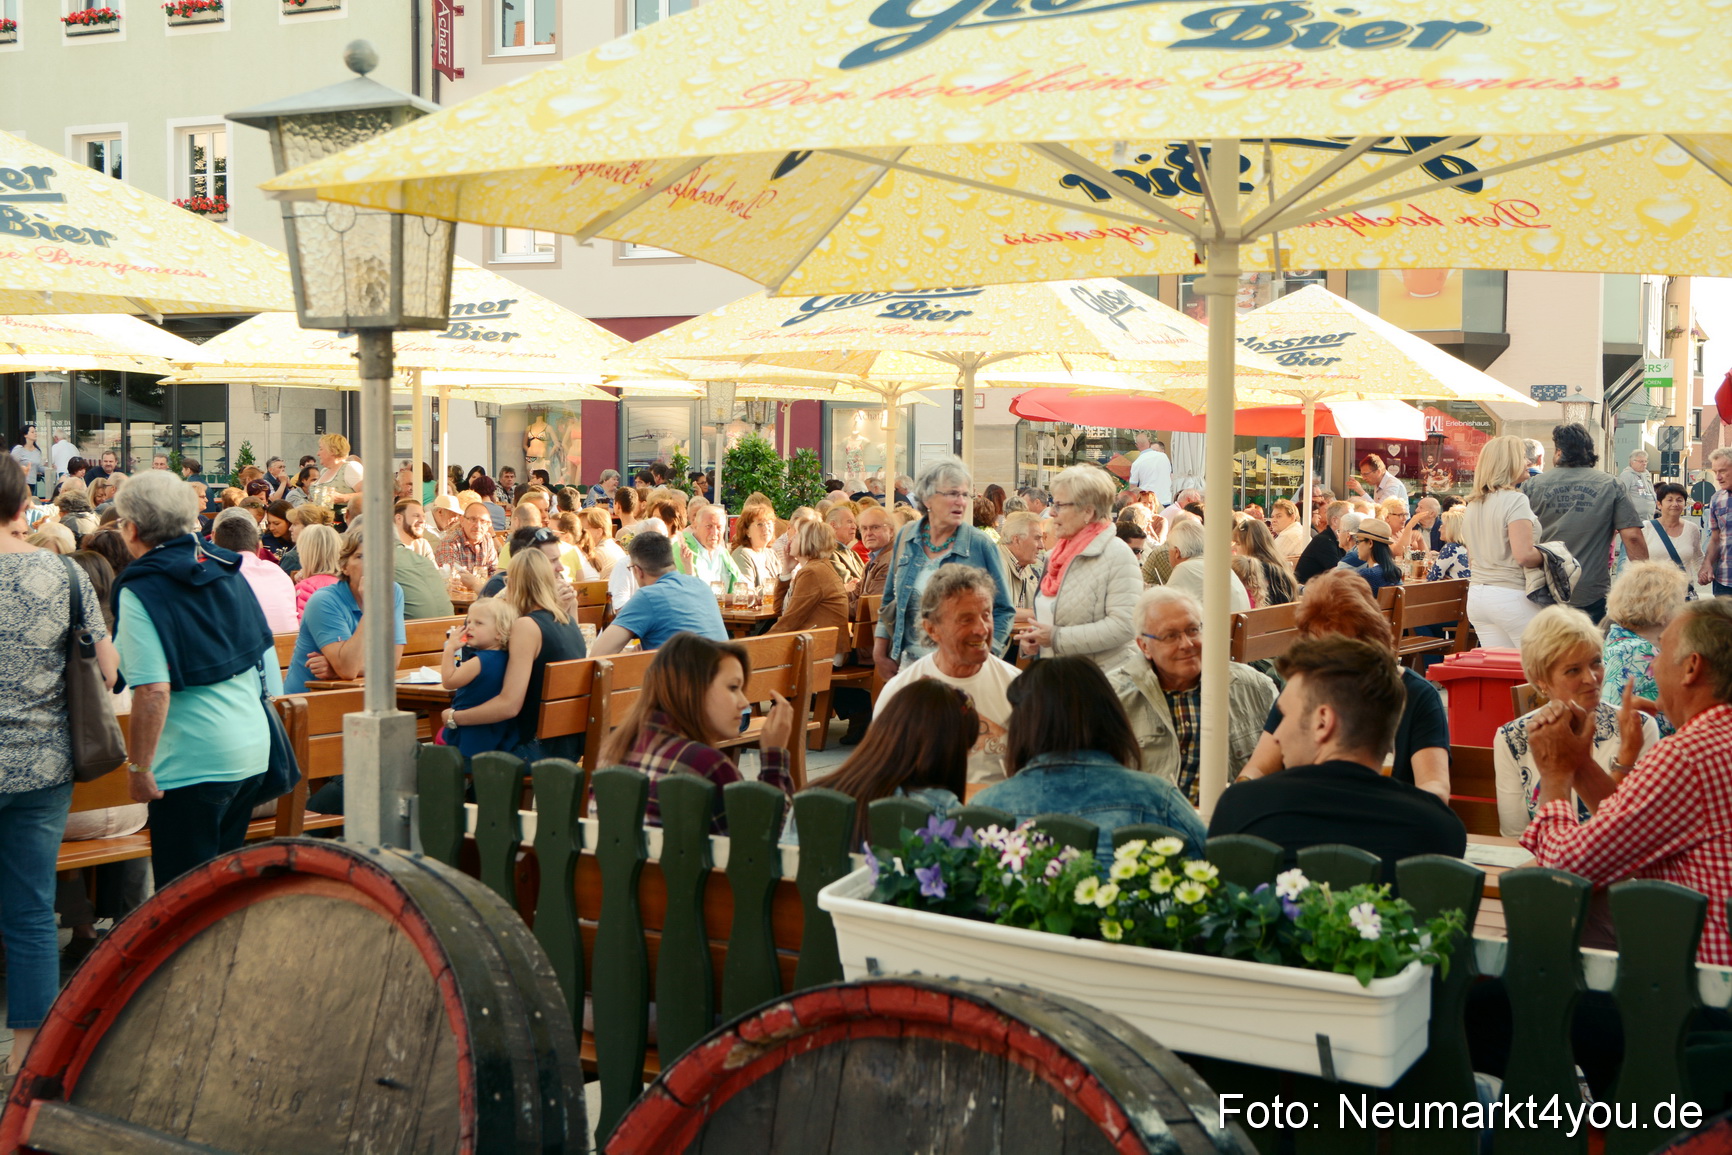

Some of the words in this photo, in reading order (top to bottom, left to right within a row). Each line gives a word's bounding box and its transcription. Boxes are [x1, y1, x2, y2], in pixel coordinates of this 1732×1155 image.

[437, 0, 450, 66] Achatz
[1166, 0, 1491, 50] Bier
[716, 78, 857, 110] Der
[870, 64, 1172, 106] hochfeine
[1203, 60, 1622, 100] Biergenuss
[0, 204, 117, 248] Bier
[35, 245, 208, 279] Biergenuss
[876, 300, 974, 322] Bier
[437, 321, 521, 343] Bier
[1275, 351, 1342, 367] Bier
[1424, 416, 1442, 431] CKL
